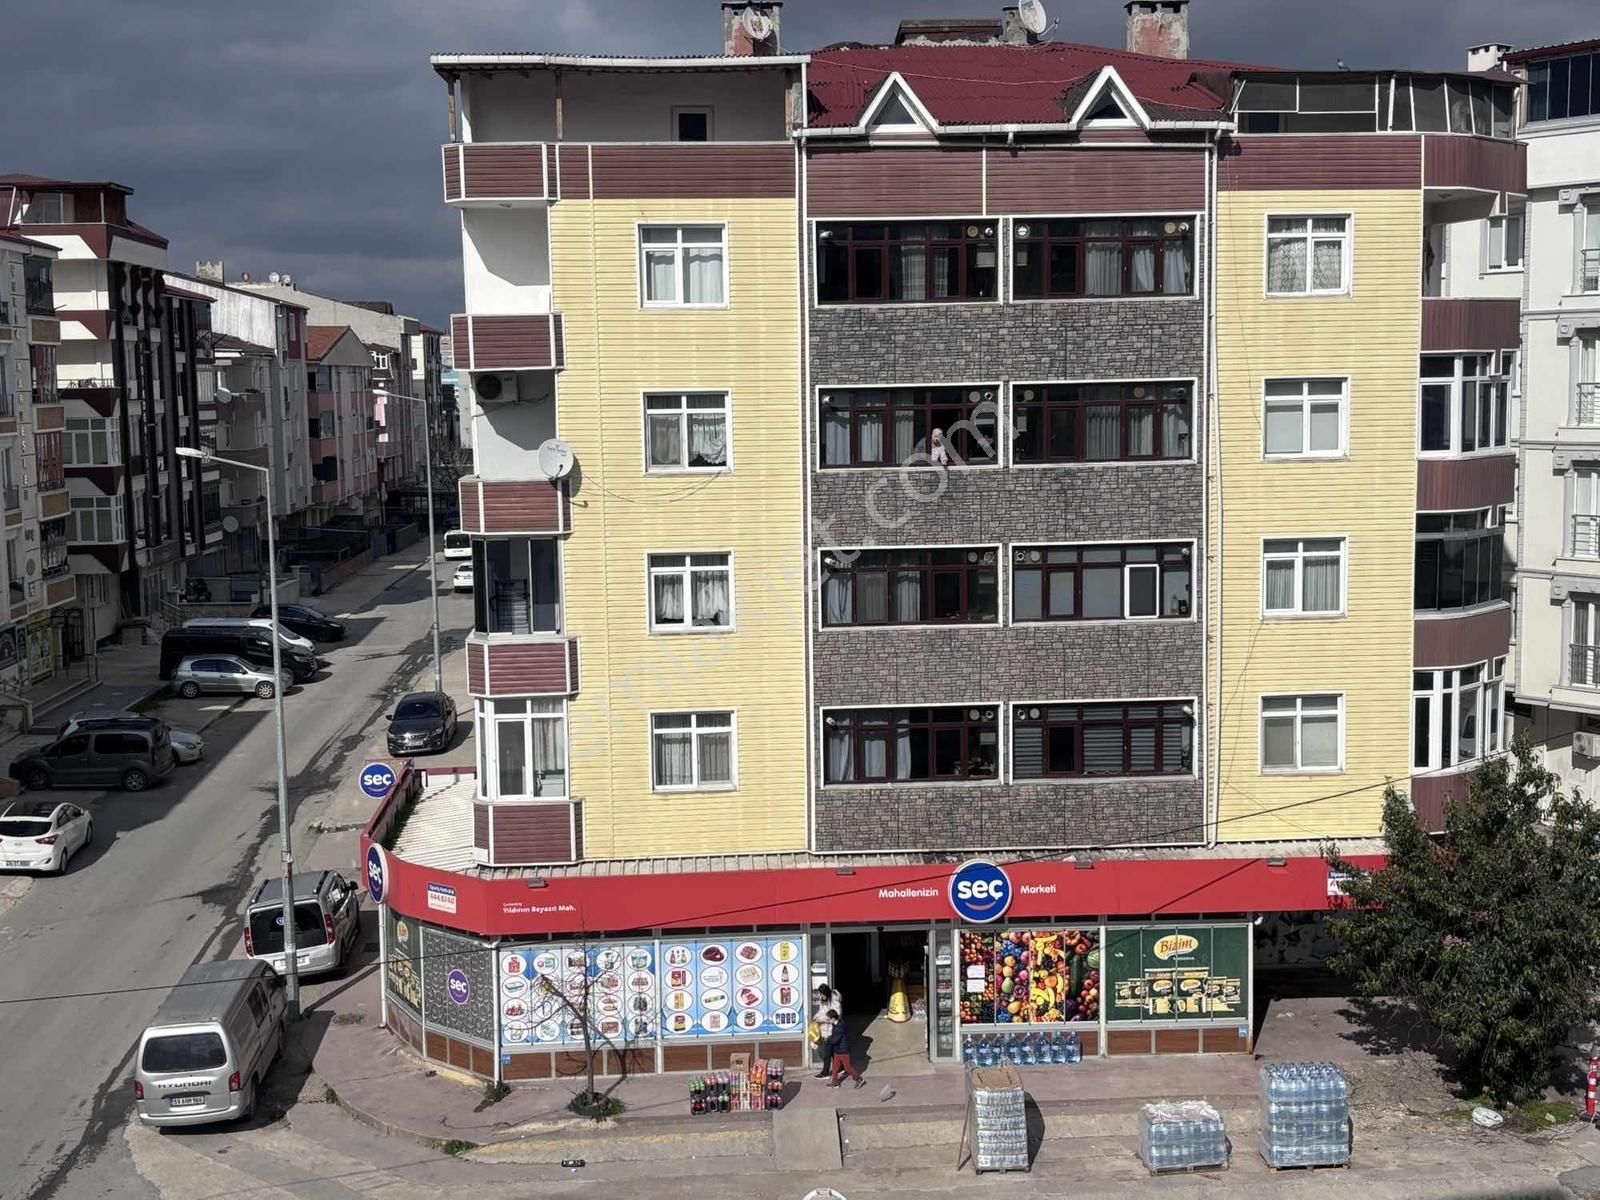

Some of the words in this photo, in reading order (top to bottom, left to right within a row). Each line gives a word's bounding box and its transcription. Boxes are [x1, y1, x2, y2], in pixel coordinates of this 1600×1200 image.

[363, 773, 392, 785] seç
[878, 887, 939, 898] Mahallenizin
[957, 879, 1004, 900] seç
[1020, 883, 1056, 894] Marketi
[1159, 937, 1194, 954] Bizim
[158, 1080, 212, 1088] HYUNDAI
